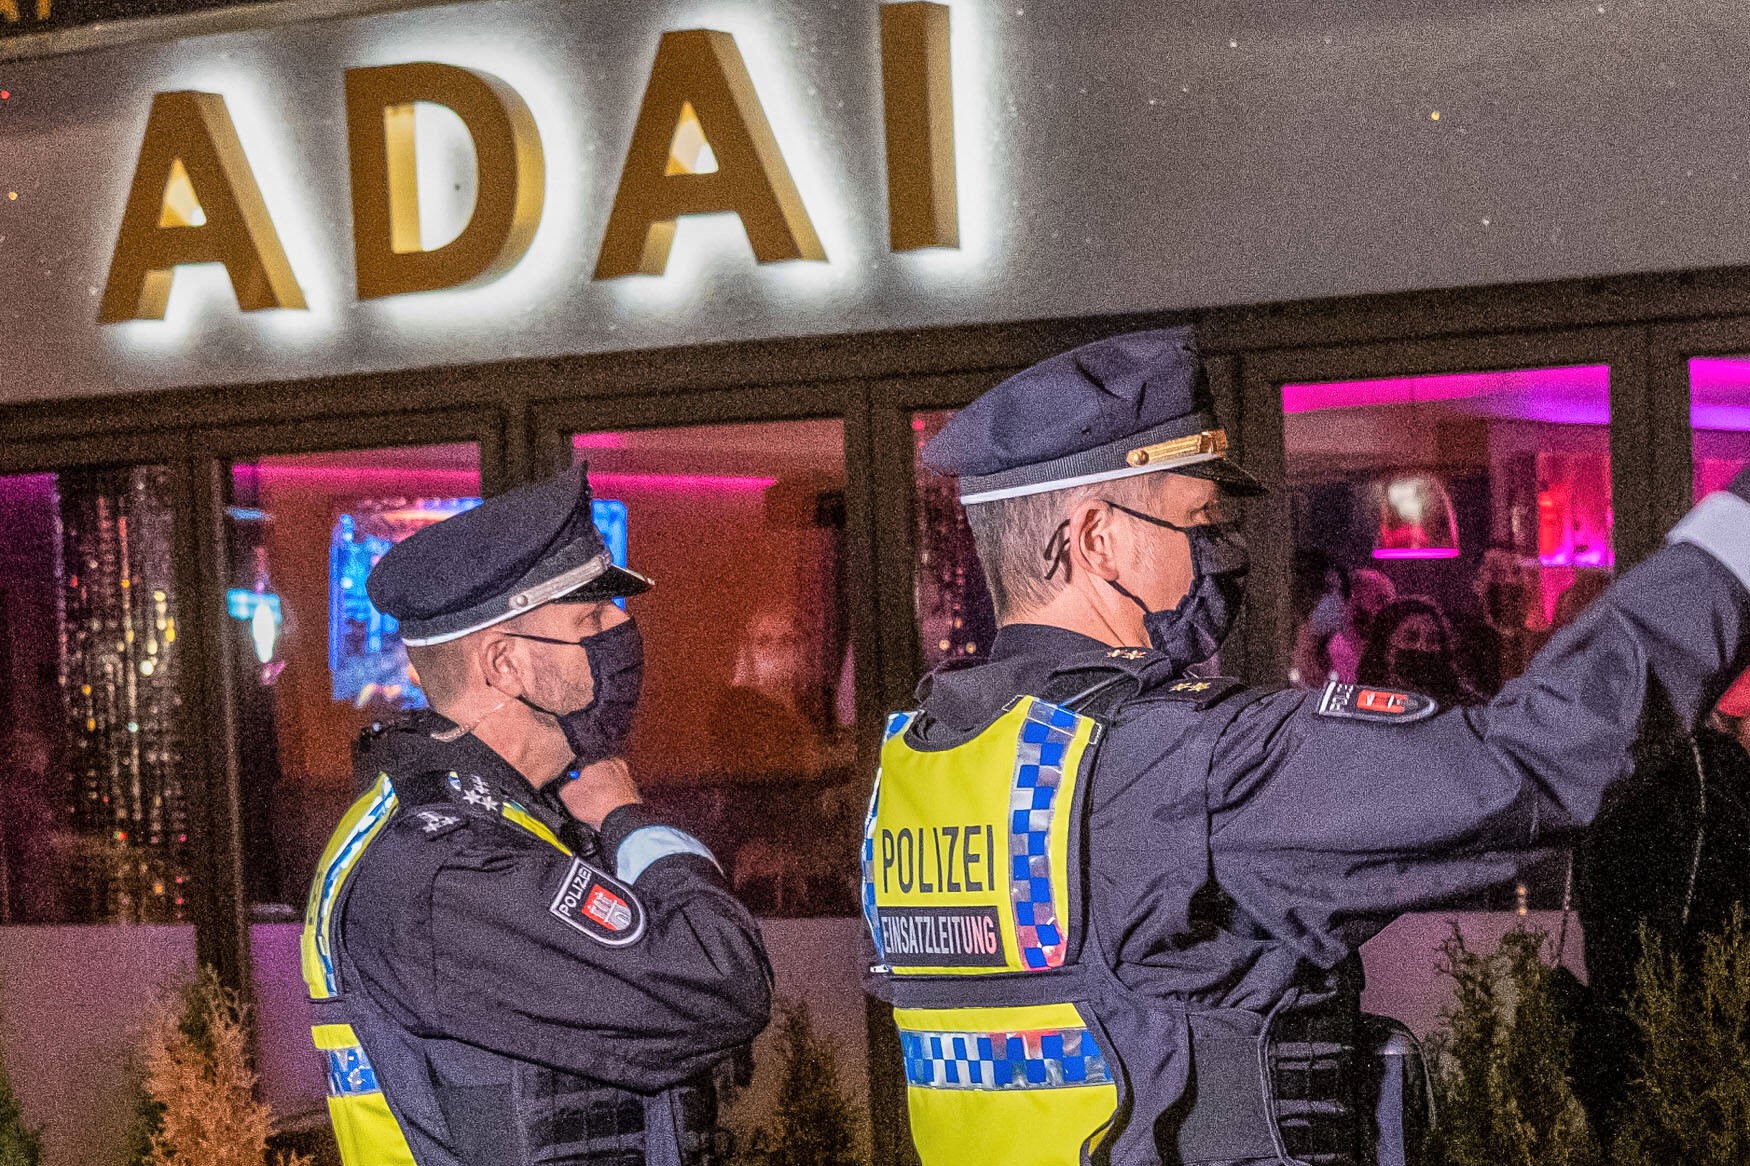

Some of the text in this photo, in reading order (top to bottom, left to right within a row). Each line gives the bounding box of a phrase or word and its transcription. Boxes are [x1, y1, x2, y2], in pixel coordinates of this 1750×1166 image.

[97, 1, 961, 324] ADAI
[882, 824, 995, 894] POLIZEI
[558, 865, 593, 917] POLIZEI
[881, 915, 998, 955] EINSATZLEITUNG
